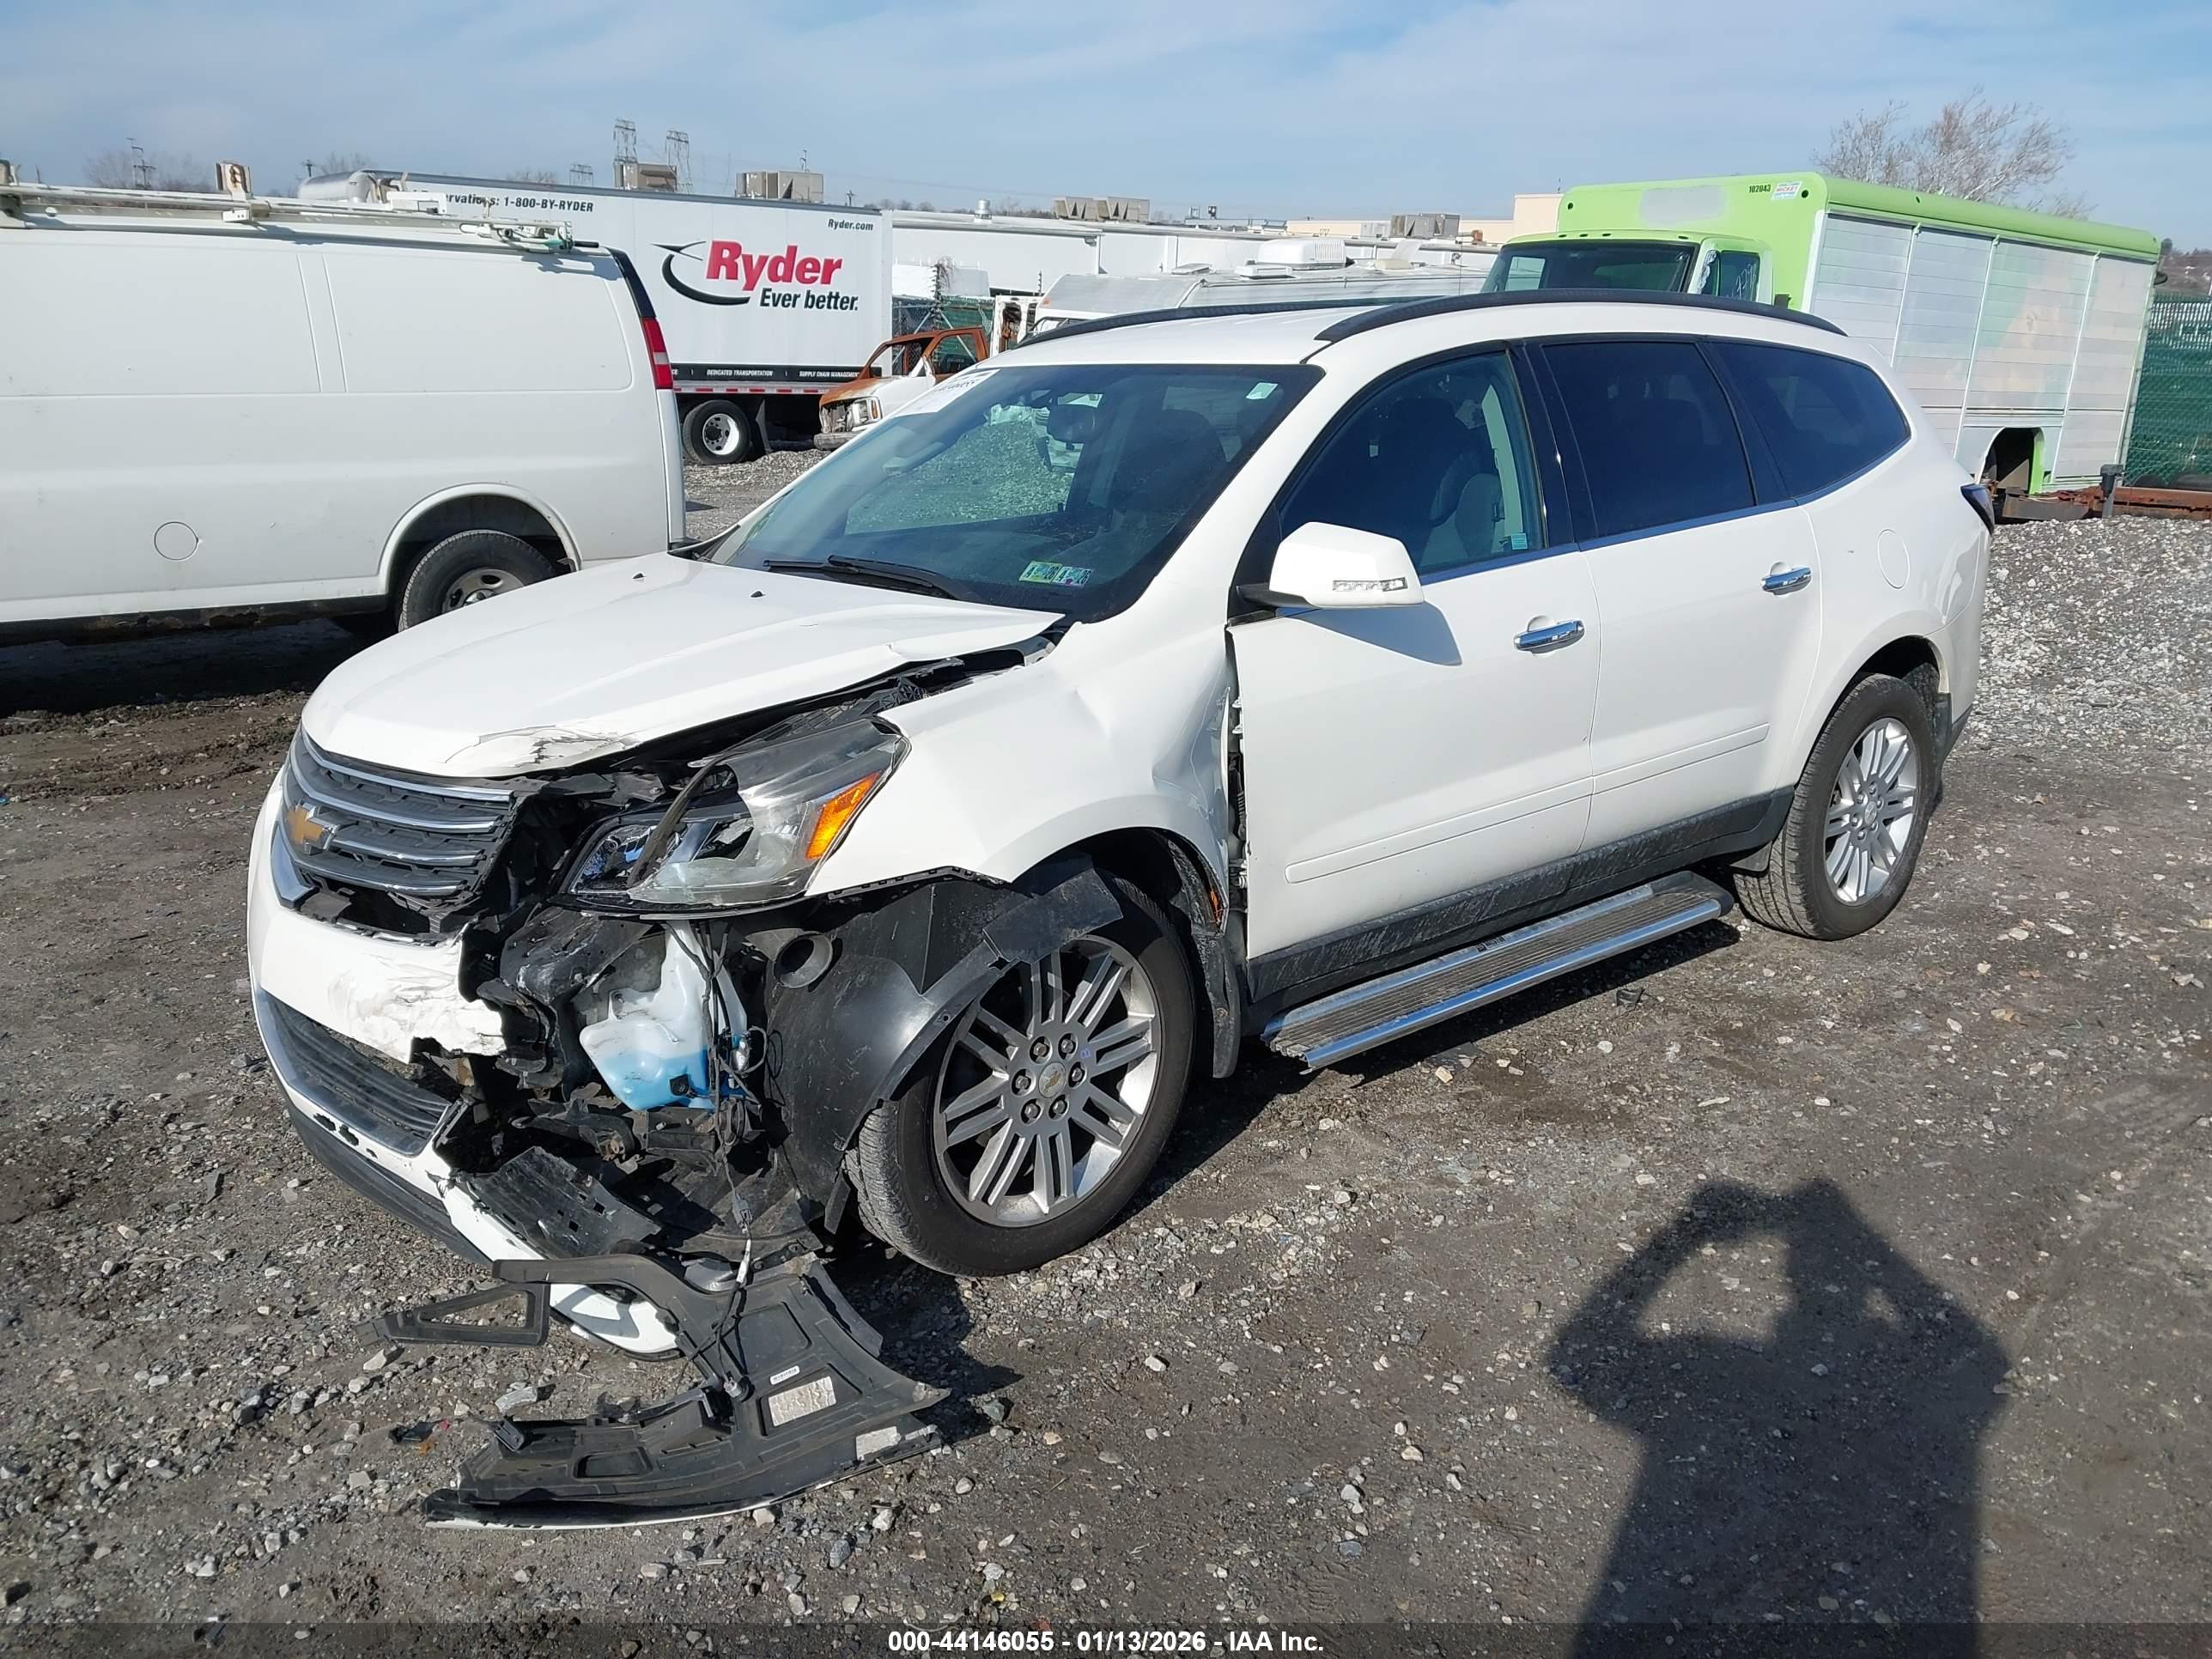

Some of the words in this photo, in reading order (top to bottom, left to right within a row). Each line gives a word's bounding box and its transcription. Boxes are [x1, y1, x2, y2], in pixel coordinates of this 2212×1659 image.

[1748, 184, 1771, 193] 102043
[504, 196, 594, 213] 1-800-BY-RYDER
[828, 218, 874, 232] Ryder.com
[706, 240, 843, 291] Ryder
[760, 287, 800, 309] Ever
[803, 289, 859, 311] better.
